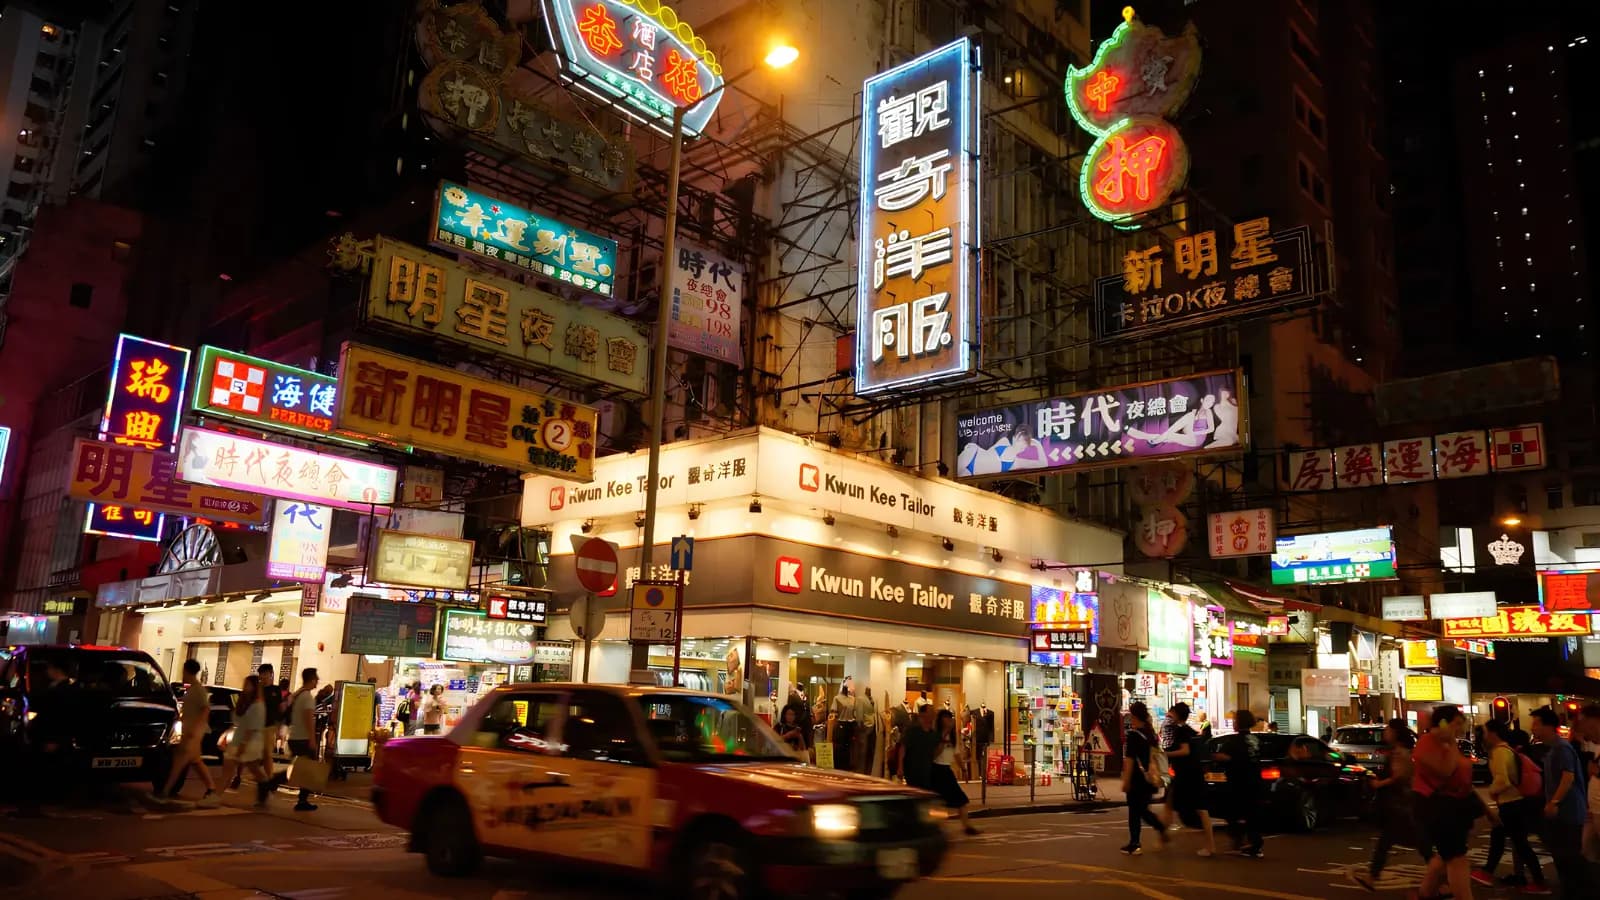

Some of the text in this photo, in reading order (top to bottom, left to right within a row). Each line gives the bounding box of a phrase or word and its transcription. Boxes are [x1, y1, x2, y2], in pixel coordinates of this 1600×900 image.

[629, 16, 660, 82] 酒店
[665, 50, 702, 104] 花
[1086, 71, 1118, 112] 中
[1096, 135, 1166, 203] 押
[455, 203, 602, 277] 幸運別墅
[871, 79, 953, 363] 觀奇洋服
[679, 247, 736, 292] 時代
[1122, 216, 1278, 294] 新明星
[687, 278, 727, 302] 夜總會
[705, 299, 731, 320] 98
[387, 255, 637, 376] 明星夜總會
[705, 319, 731, 337] 198
[115, 358, 171, 449] 瑞興
[270, 407, 333, 432] PERFECT
[351, 361, 511, 449] 新明星
[959, 414, 1003, 429] welcome
[1037, 394, 1190, 441] 時代 夜總會
[551, 424, 564, 445] 2
[76, 446, 193, 508] 明星
[214, 440, 350, 498] 時代夜總會
[569, 486, 602, 505] Kwun
[607, 479, 633, 498] Kee
[688, 458, 747, 485] 觀奇洋服
[283, 503, 323, 531] 代
[825, 474, 864, 500] Kwun
[870, 485, 896, 507] Kee
[901, 493, 936, 518] Tailor
[953, 507, 998, 533] 觀奇洋服
[664, 612, 671, 621] 7
[810, 565, 864, 598] Kwun
[870, 576, 904, 603] Kee
[909, 583, 954, 610] Tailor
[969, 593, 1025, 620] 觀奇洋服
[660, 629, 671, 639] 12
